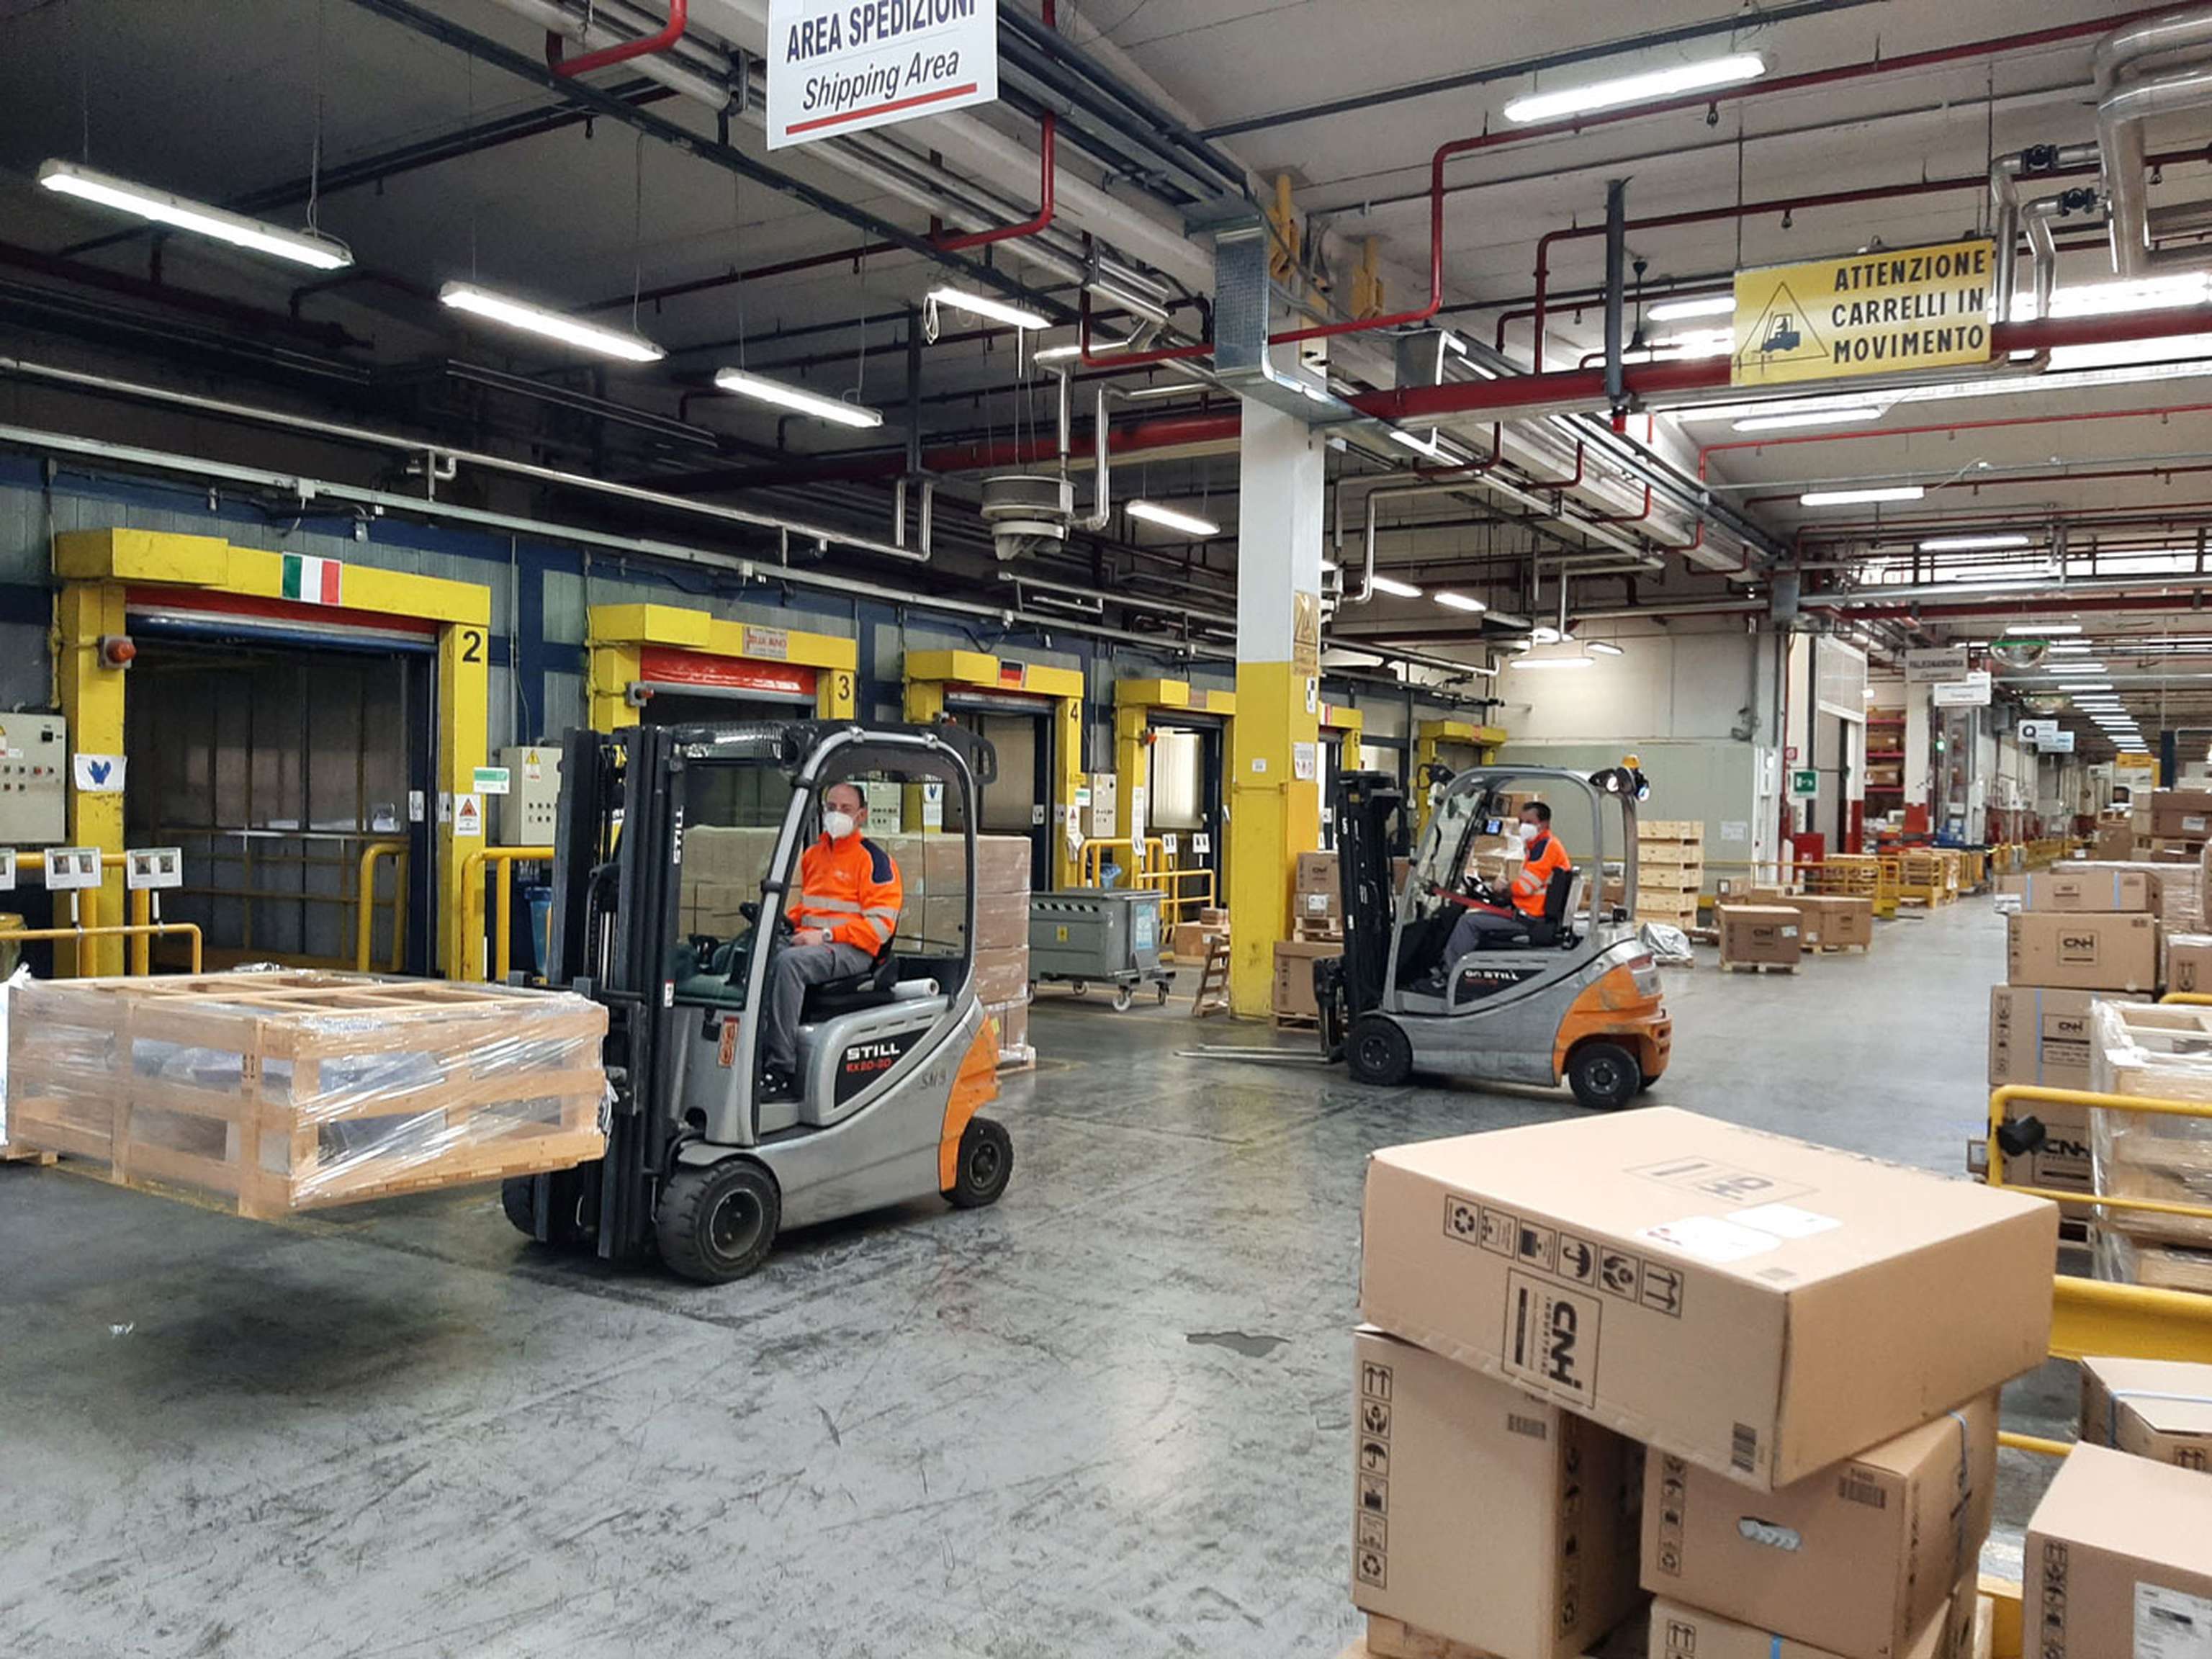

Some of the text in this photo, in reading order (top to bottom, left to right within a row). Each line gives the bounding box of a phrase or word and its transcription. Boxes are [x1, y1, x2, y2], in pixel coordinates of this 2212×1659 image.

[786, 13, 842, 63] AREA
[803, 50, 959, 112] Shipping Area
[1834, 250, 1985, 292] ATTENZIONE
[1832, 288, 1984, 327] CARRELLI IN
[1833, 325, 1983, 364] MOVIMENTO
[462, 630, 481, 662] 2
[838, 675, 850, 700] 3
[1070, 702, 1079, 721] 4
[2022, 724, 2037, 739] Q
[673, 805, 685, 865] STILL
[2063, 935, 2094, 948] CNH
[1483, 969, 1519, 981] STILL
[847, 1043, 900, 1061] STILL
[1549, 1300, 1583, 1390] CNH
